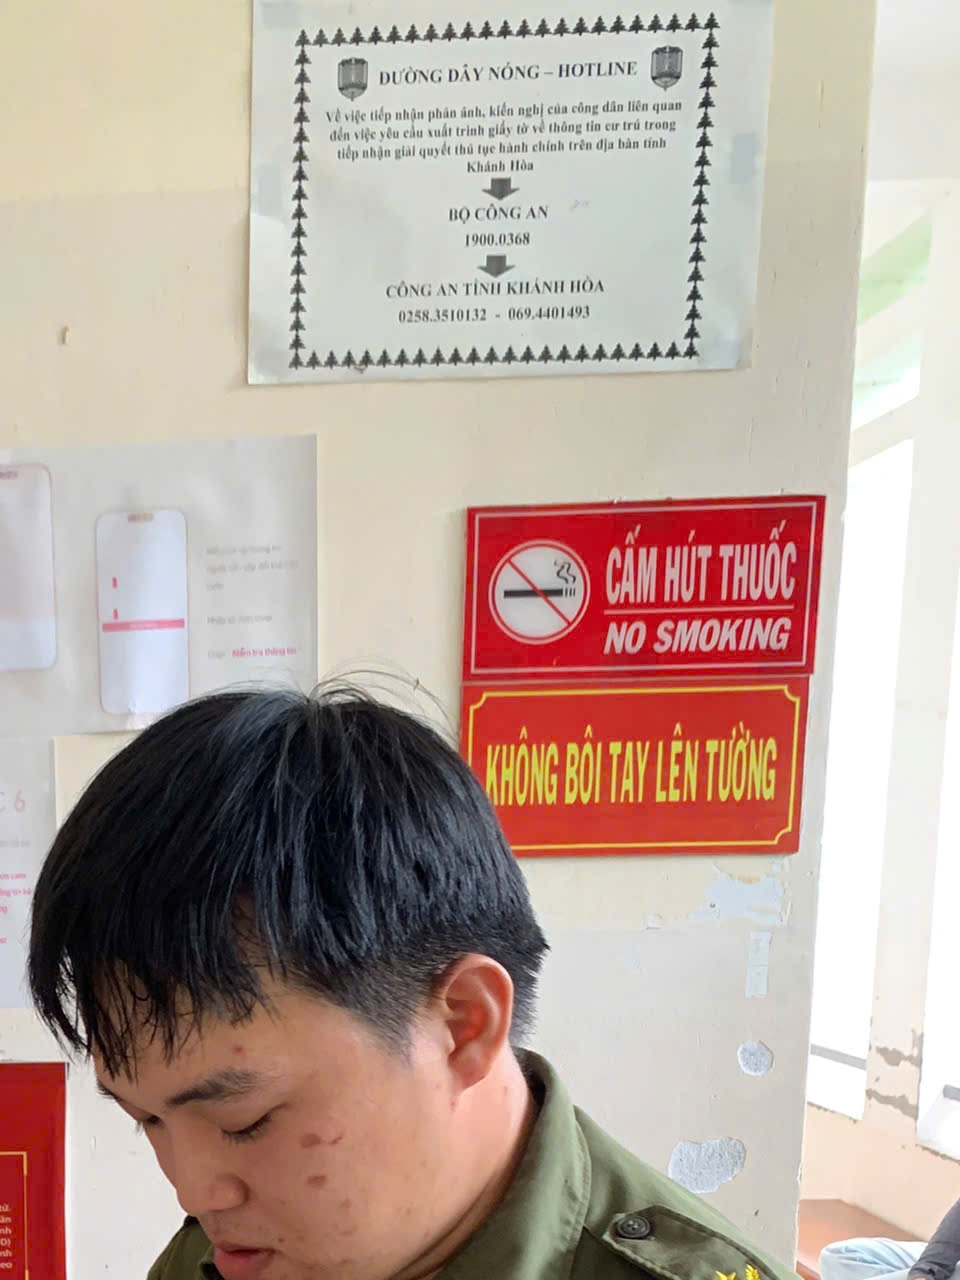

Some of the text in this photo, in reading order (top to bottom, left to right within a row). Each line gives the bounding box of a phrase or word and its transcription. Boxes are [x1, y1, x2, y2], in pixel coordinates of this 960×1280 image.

[379, 61, 637, 85] ĐƯỜNG DÂY NÓNG HOTLINE
[326, 109, 340, 123] Về
[344, 109, 366, 124] việc
[370, 106, 391, 124] tiếp
[395, 107, 424, 124] nhận
[489, 102, 514, 117] kiến
[518, 102, 544, 118] nghị
[547, 103, 568, 115] của
[571, 101, 598, 115] công
[602, 101, 623, 113] dân
[627, 100, 648, 112] liên
[652, 102, 682, 114] quan
[330, 126, 349, 142] đến
[354, 126, 376, 142] việc
[379, 126, 399, 142] yêu
[403, 124, 423, 138] cầu
[427, 123, 452, 138] xuất
[455, 124, 484, 137] trình
[488, 120, 512, 137] giấy
[517, 122, 528, 135] tờ
[532, 120, 545, 134] về
[549, 121, 582, 135] thông
[586, 120, 601, 132] tin
[604, 121, 620, 132] cư
[644, 120, 676, 132] trong
[337, 144, 359, 161] tiếp
[362, 145, 391, 160] nhận
[419, 143, 451, 159] quyết
[477, 143, 495, 157] tục
[499, 140, 528, 153] hành
[532, 139, 564, 152] chính
[568, 139, 592, 151] trên
[596, 138, 614, 153] địa
[618, 137, 639, 149] bàn
[467, 158, 534, 173] Khánh Hòa
[448, 203, 549, 224] BỘ CÔNG AN
[464, 232, 531, 248] 1900.0368
[386, 275, 605, 298] CÔNG AN TỈNH KHÁNH HÒA
[398, 305, 591, 324] 0258.3510132 069.4401493
[604, 520, 798, 605] CẤM HÚT THUỐC
[603, 616, 791, 655] NO SMOKING
[485, 721, 778, 806] KHÔNG BÔI TAY LÊN TƯỜNG
[13, 790, 27, 813] 6
